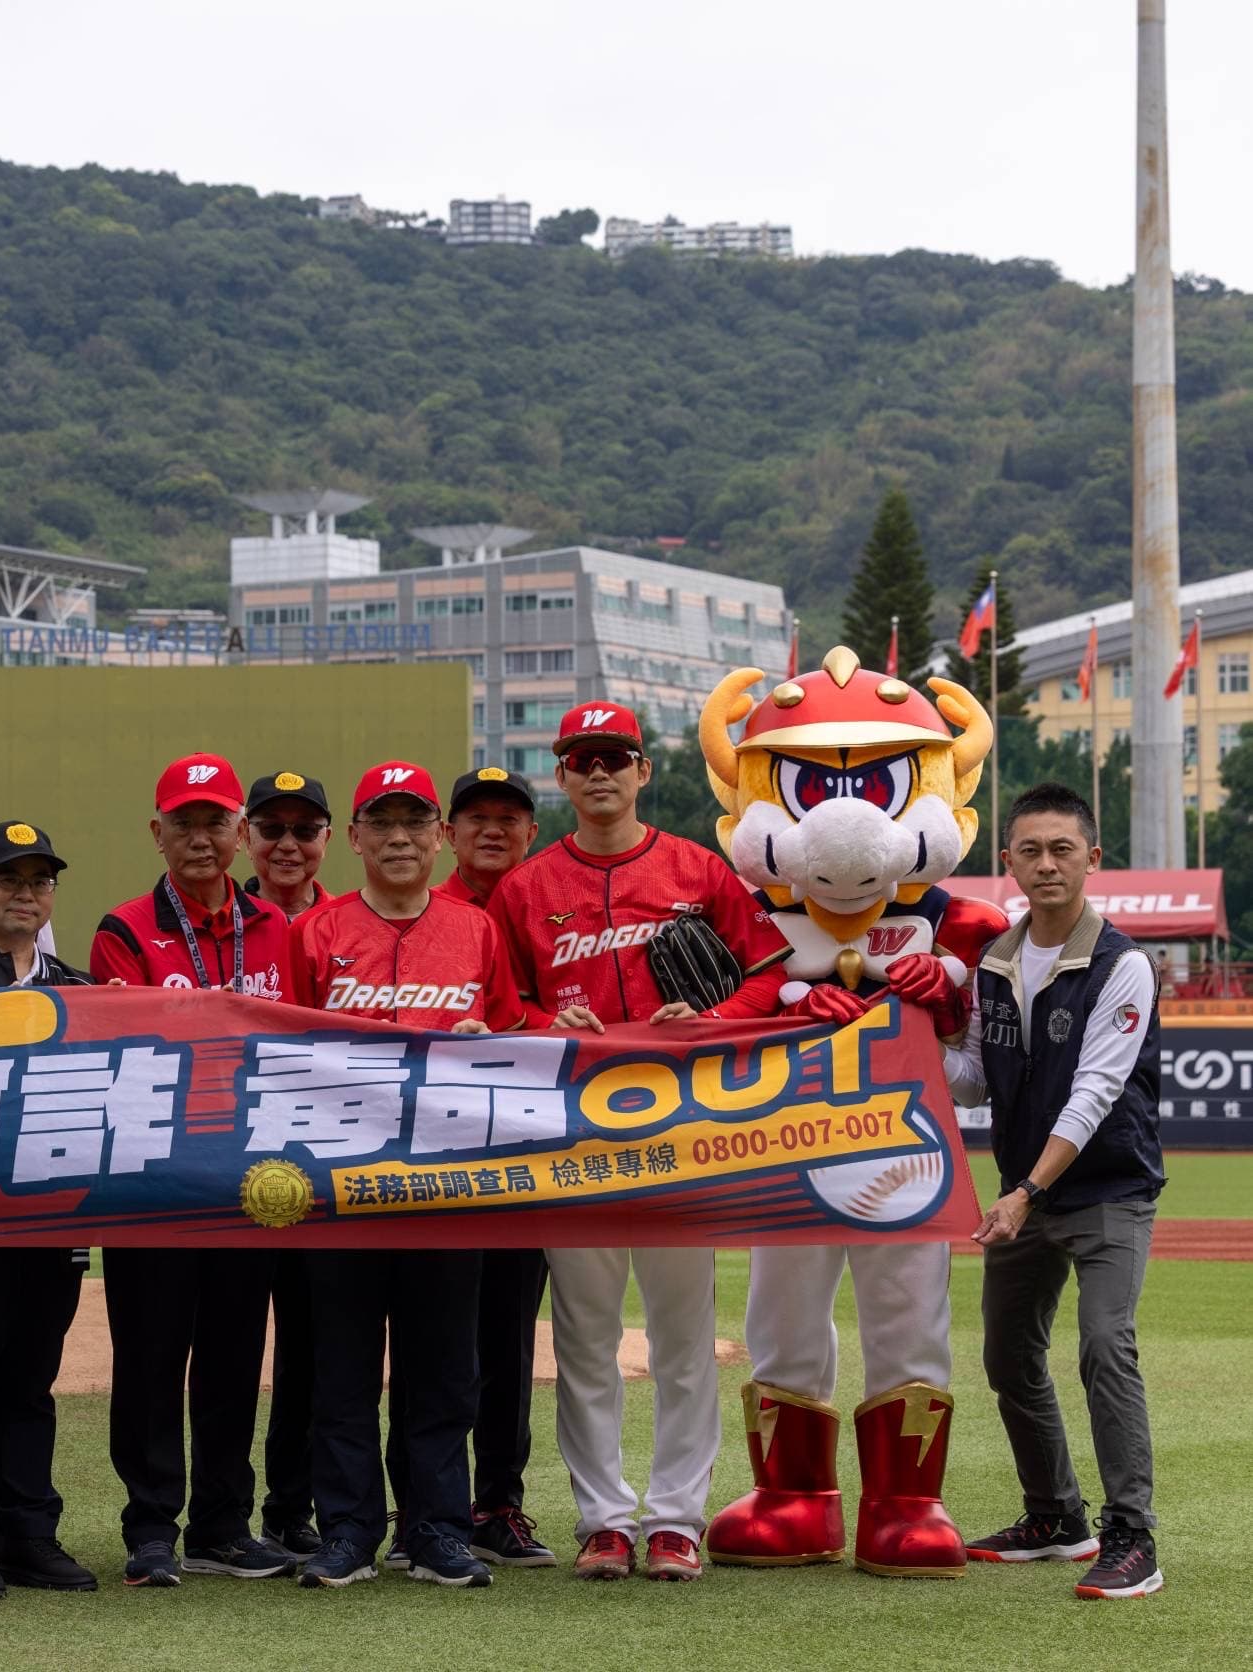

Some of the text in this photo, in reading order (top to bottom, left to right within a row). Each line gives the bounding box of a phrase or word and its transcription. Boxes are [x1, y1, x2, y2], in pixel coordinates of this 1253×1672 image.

[1, 623, 430, 654] TIANMU BASEBALL STADIUM
[582, 709, 616, 729] W
[186, 764, 219, 785] W
[381, 767, 415, 786] W
[867, 925, 917, 956] W
[692, 1110, 895, 1165] 0800-007-007
[343, 1142, 681, 1207] 法務部調查局 檢舉專線
